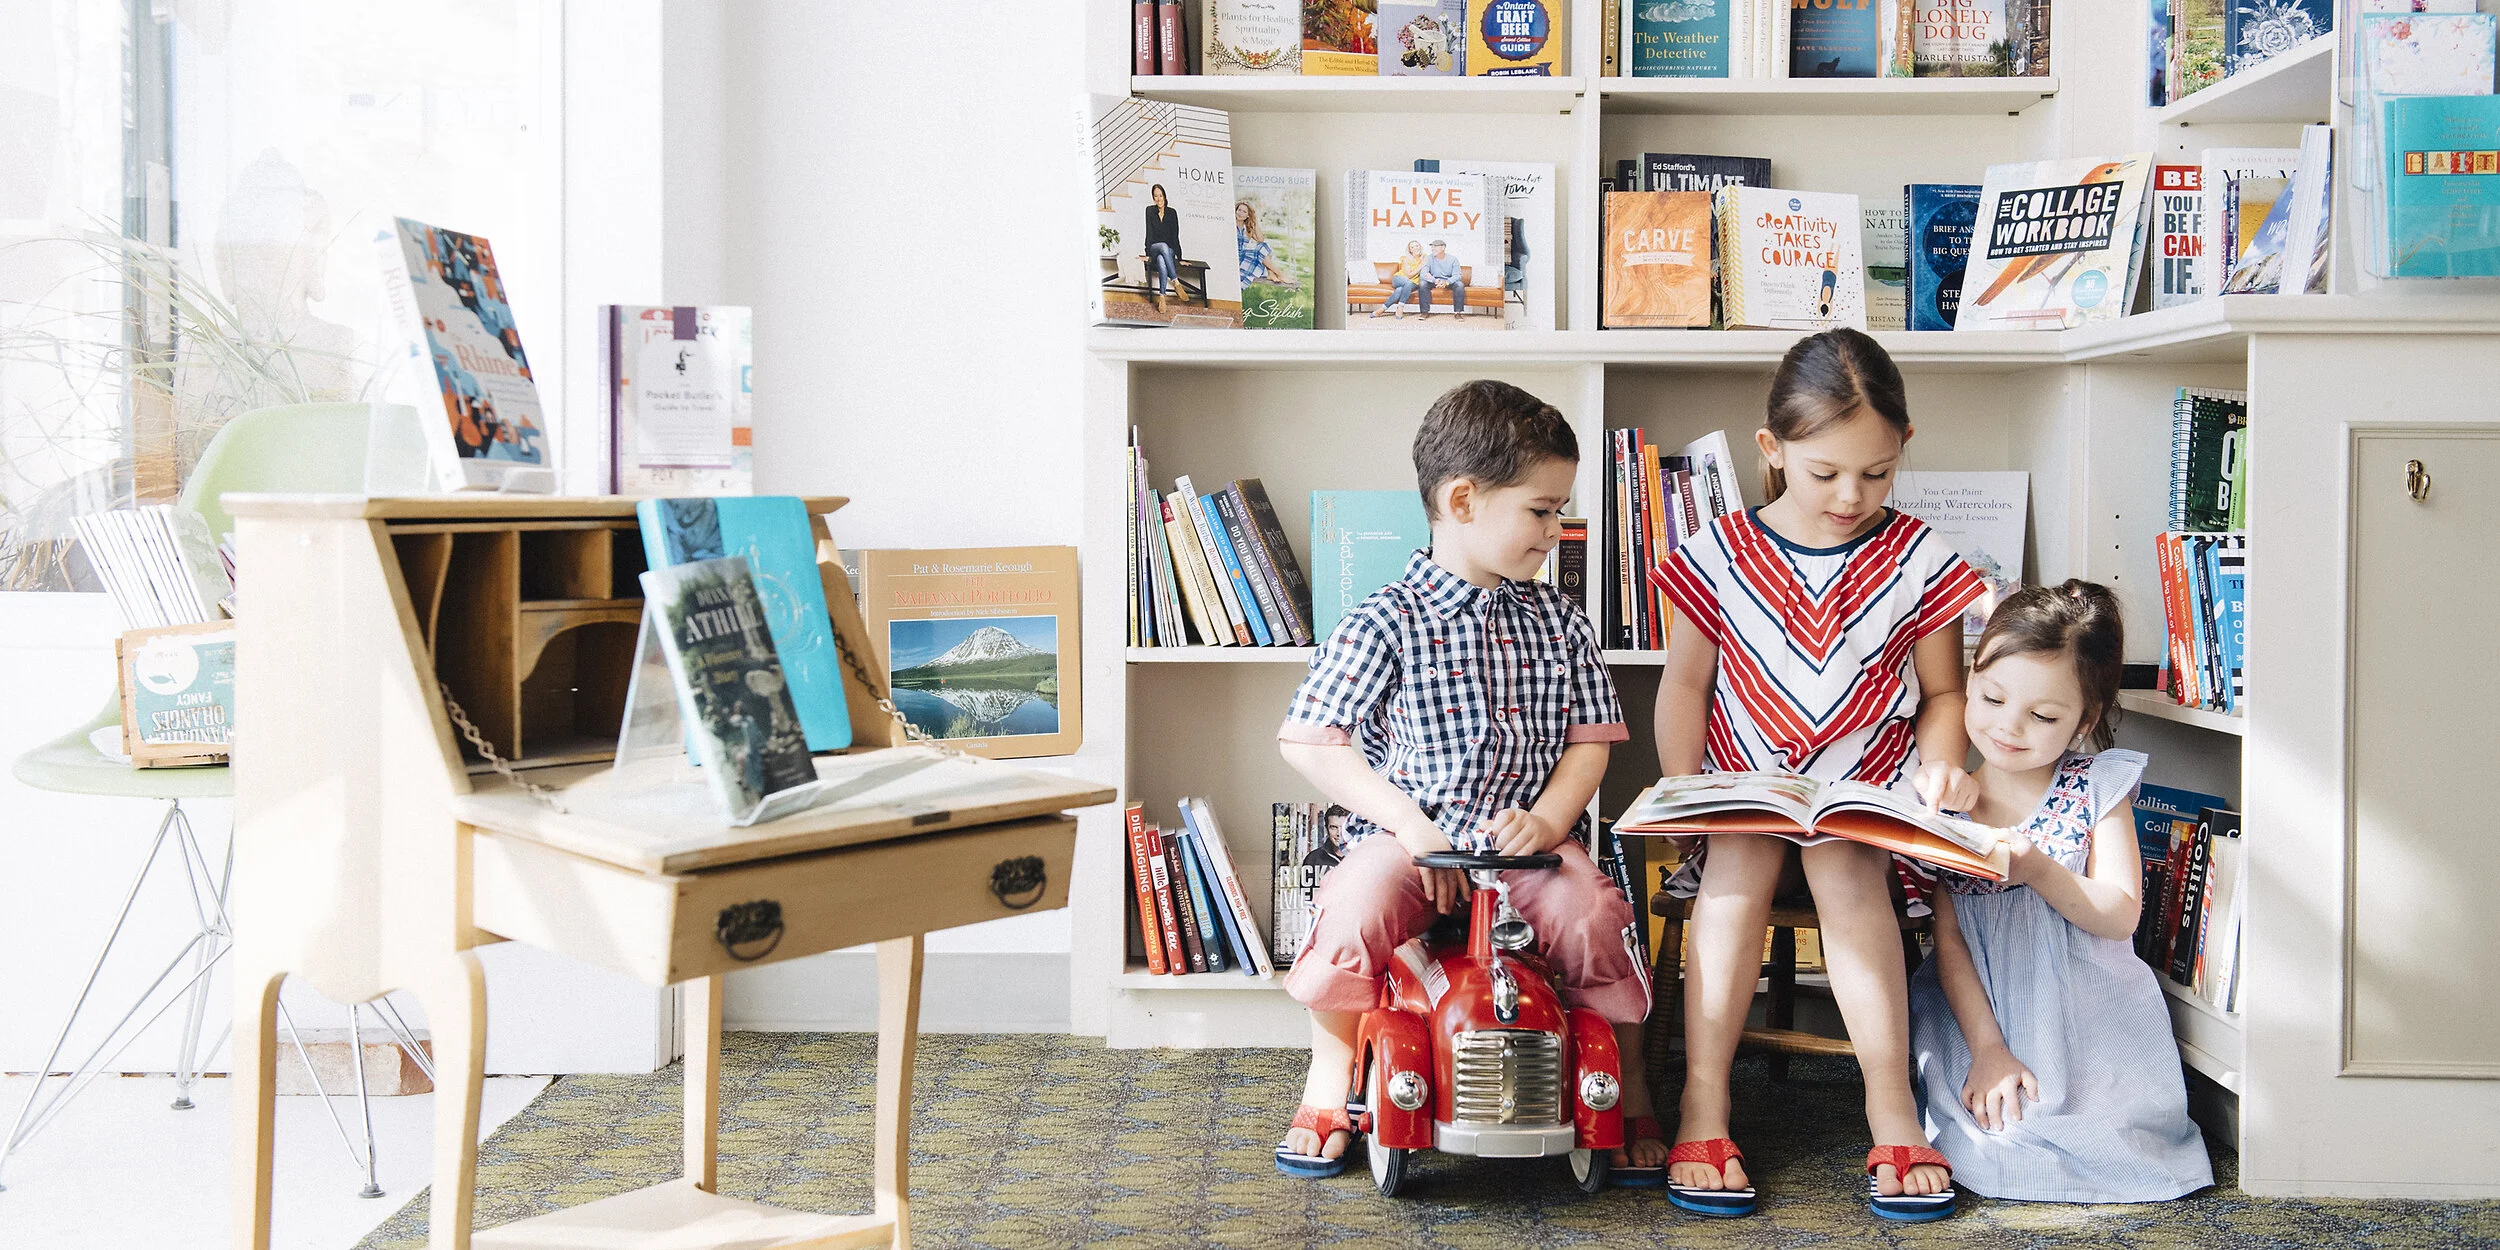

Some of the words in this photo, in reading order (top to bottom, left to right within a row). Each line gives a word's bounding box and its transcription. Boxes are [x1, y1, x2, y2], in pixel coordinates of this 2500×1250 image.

[1503, 1, 1536, 10] Ontario
[1221, 13, 1247, 21] Plants
[1249, 13, 1260, 22] for
[1497, 11, 1535, 23] CRAFT
[1915, 9, 1993, 24] LONELY
[1235, 25, 1281, 35] Spirituality
[1501, 23, 1530, 36] BEER
[1608, 15, 1616, 48] YUKON
[1925, 25, 1986, 40] DOUG
[1250, 36, 1274, 46] Magic
[1634, 32, 1659, 44] The
[1662, 32, 1719, 45] Weather
[1500, 44, 1531, 52] GUIDE
[1645, 48, 1707, 59] Detective
[1915, 53, 1955, 62] HARLEY
[1957, 54, 1996, 63] RUSTAD
[1179, 166, 1225, 185] HOME
[1663, 163, 1696, 172] Stafford's
[1238, 175, 1286, 185] CAMERON
[1288, 176, 1311, 186] BURE
[1423, 178, 1444, 186] Dave
[1652, 173, 1745, 192] ULTIMATE
[1391, 186, 1463, 207] LIVE
[1999, 198, 2014, 218] THE
[2011, 184, 2120, 220] COLLAGE
[2163, 195, 2193, 212] YOU
[1372, 209, 1481, 231] HAPPY
[1865, 209, 1888, 217] HOW
[1890, 209, 1902, 217] TO
[1933, 225, 1957, 233] BRIEF
[1995, 214, 2112, 246] WORKBOOK
[2164, 213, 2188, 234] BE
[1623, 228, 1695, 252] CARVE
[1773, 232, 1821, 249] TAKES
[1949, 236, 1962, 244] TO
[1990, 248, 2002, 256] HOW
[2003, 247, 2010, 255] TO
[2012, 246, 2024, 254] GET
[2025, 243, 2049, 253] STARTED
[2050, 242, 2062, 251] AND
[2063, 241, 2077, 250] STAY
[2078, 239, 2107, 248] INSPIRED
[1761, 247, 1837, 269] COURAGE
[1932, 247, 1948, 255] BIG
[1253, 299, 1304, 325] Stylish
[455, 343, 518, 377] Rhine
[1923, 488, 1939, 496] You
[1942, 488, 1959, 496] Can
[1961, 488, 1983, 496] Paint
[1893, 499, 1941, 510] Dazzling
[1945, 499, 2013, 509] Watercolors
[1183, 482, 1192, 497] The
[1189, 497, 1202, 523] Wealthy
[1199, 523, 1212, 548] Barber
[1943, 513, 1963, 523] Easy
[1966, 513, 1999, 521] Lessons
[1205, 501, 1220, 530] DOLLARS
[1218, 532, 1226, 545] AND
[1223, 545, 1234, 567] SENSE
[1237, 505, 1248, 522] NOT
[1252, 543, 1271, 571] MONEY
[1184, 524, 1195, 553] Strategies
[1195, 561, 1210, 588] Retiring
[2158, 542, 2168, 573] Collins
[913, 564, 929, 574] Pat
[931, 564, 939, 574] &
[942, 562, 993, 573] Rosemarie
[995, 561, 1033, 574] Keough
[1231, 525, 1240, 539] DO
[1236, 537, 1247, 555] YOU
[1243, 554, 1260, 583] REALLY
[1256, 584, 1269, 606] NEED
[2173, 547, 2182, 584] Collins
[969, 588, 1053, 603] PORTFOLIO
[2162, 579, 2172, 595] Big
[2177, 588, 2186, 601] Big
[930, 608, 967, 617] Introduction
[967, 608, 975, 617] by
[975, 607, 988, 616] Nick
[2164, 595, 2175, 619] book
[2180, 601, 2189, 621] book
[2169, 632, 2177, 645] Su
[176, 692, 213, 706] FANCY
[151, 704, 225, 732] ORANGES
[966, 741, 988, 749] Canada
[1130, 815, 1140, 833] DIE
[1135, 833, 1150, 894] LAUGHING
[2178, 832, 2196, 904] Collins
[2182, 821, 2209, 928] Collins
[1144, 896, 1156, 928] WILLIAM
[1158, 889, 1174, 926] moments
[1174, 879, 1188, 917] FUNNIEST
[1183, 918, 1193, 937] EVER
[1148, 928, 1158, 956] NOVAK
